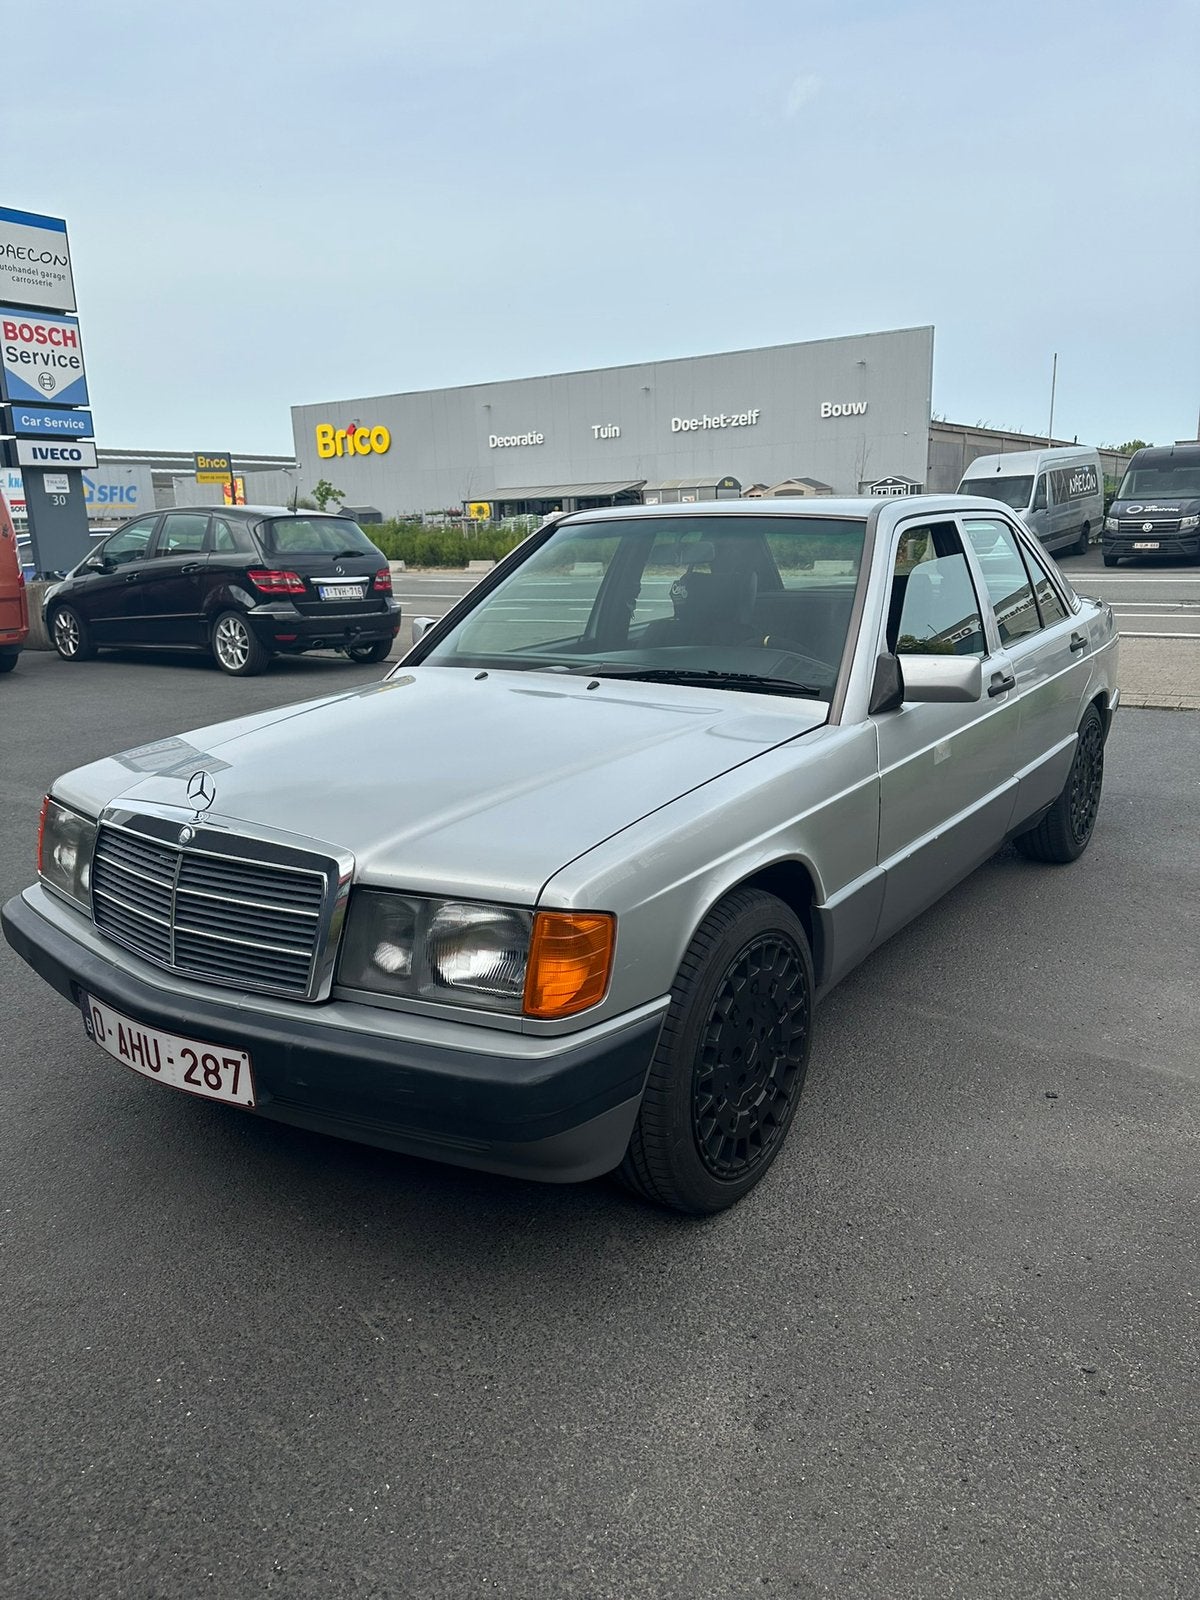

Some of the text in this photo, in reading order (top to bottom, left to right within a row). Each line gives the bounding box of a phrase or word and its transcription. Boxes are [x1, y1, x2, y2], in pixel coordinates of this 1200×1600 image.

[0, 264, 66, 281] utohandel garage
[11, 275, 53, 288] carrosserie
[3, 321, 77, 348] BOSCH
[6, 345, 81, 369] Service
[820, 400, 867, 418] Bouw
[21, 415, 85, 429] Car Service
[671, 409, 760, 432] Doe-het-zelf
[316, 422, 391, 458] Brico
[489, 431, 544, 449] Decoratie
[592, 424, 621, 439] Tuin
[32, 447, 82, 460] IVECO
[197, 456, 228, 468] Brico
[52, 495, 66, 505] 30
[97, 485, 137, 502] SFIC
[86, 1017, 94, 1034] B
